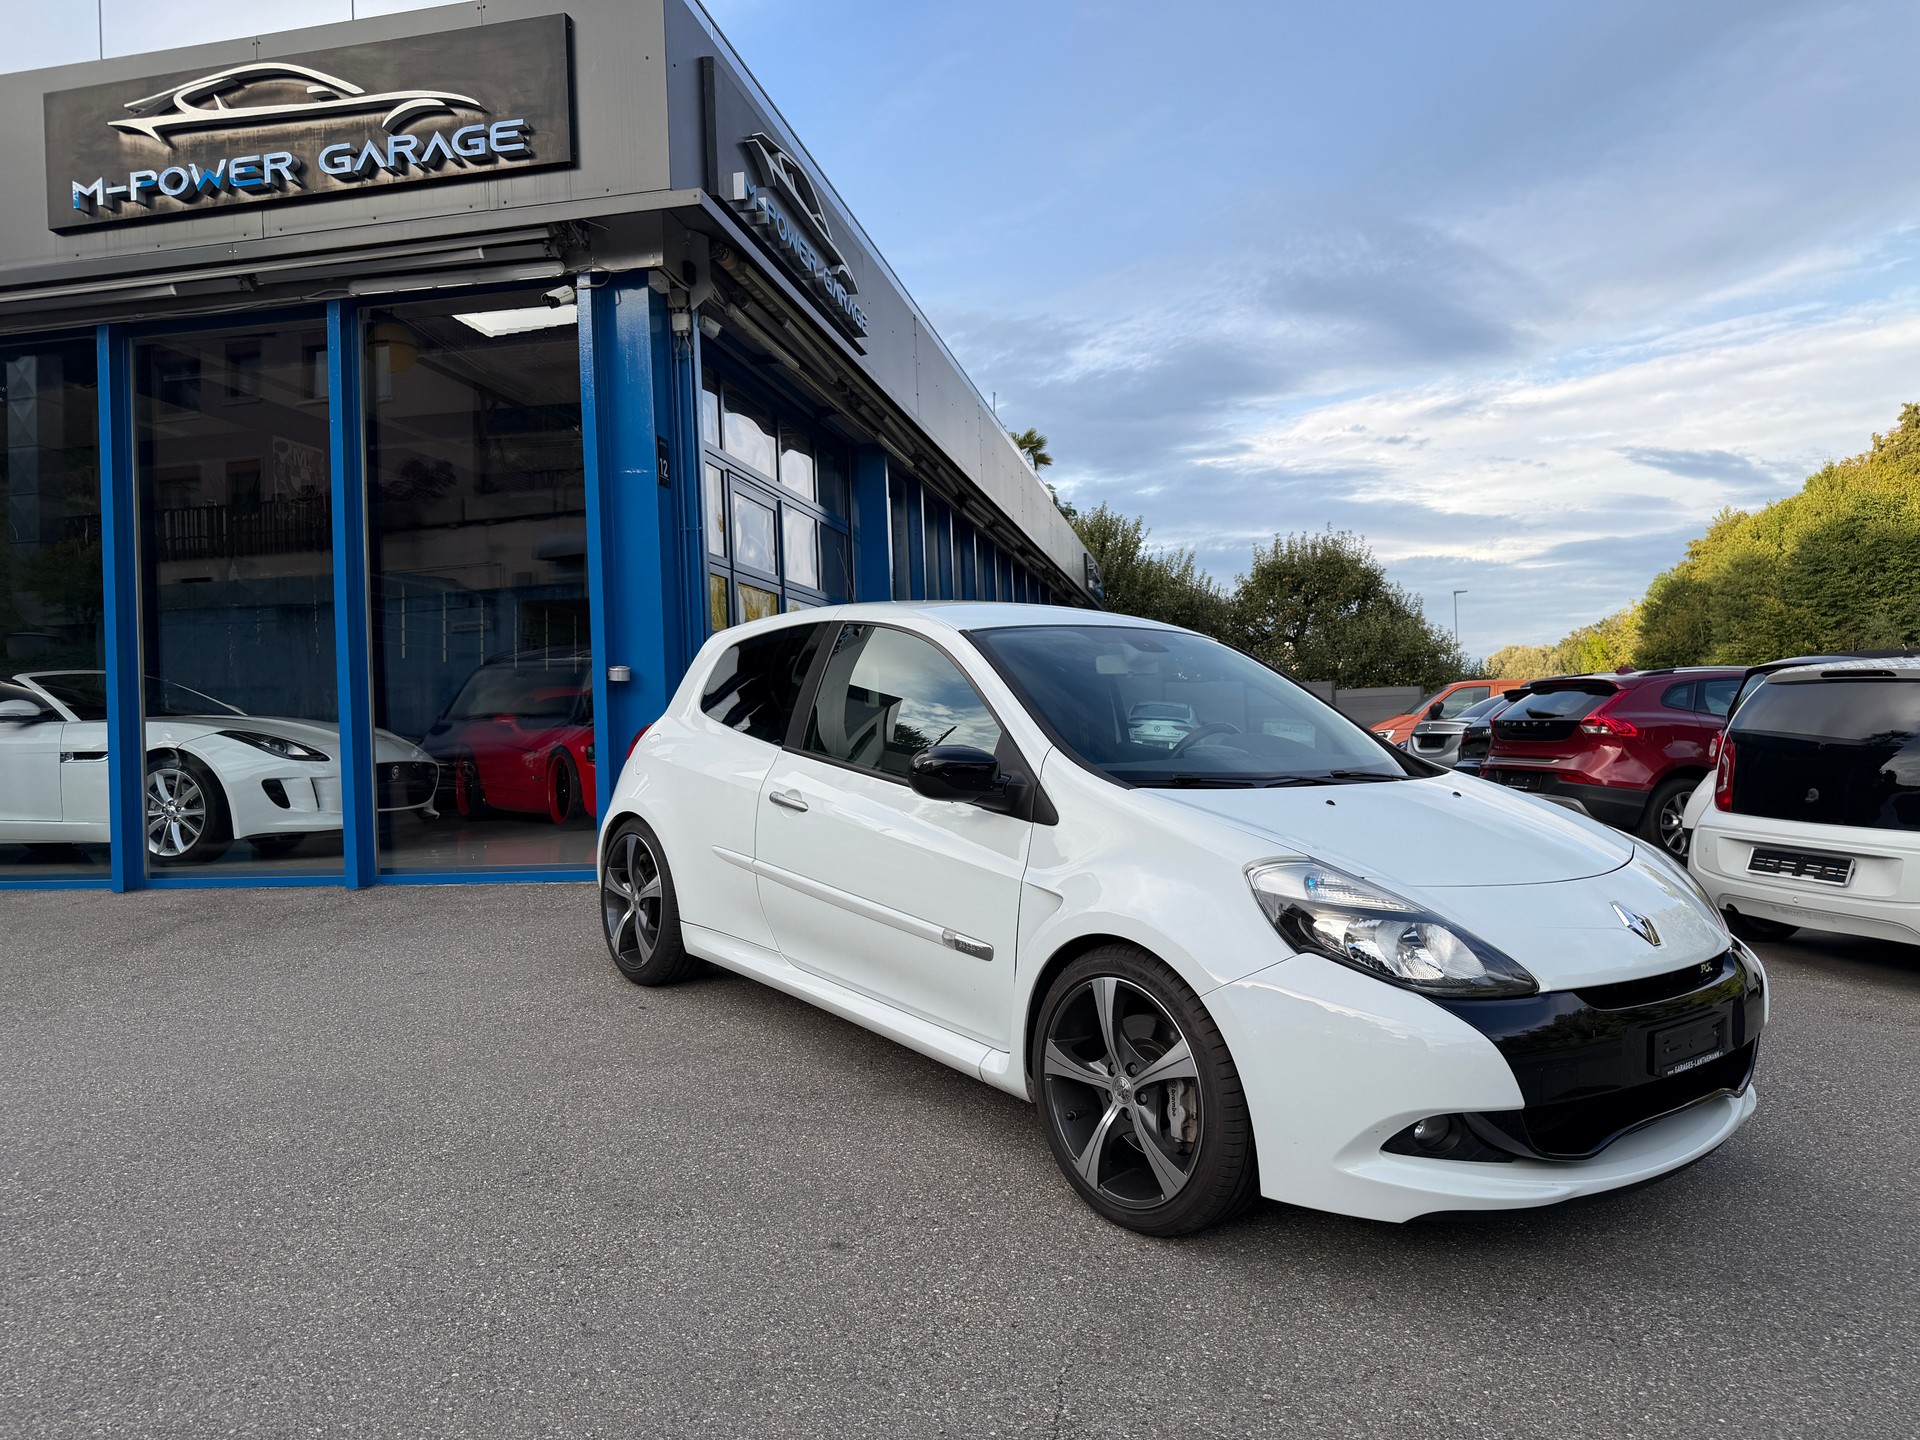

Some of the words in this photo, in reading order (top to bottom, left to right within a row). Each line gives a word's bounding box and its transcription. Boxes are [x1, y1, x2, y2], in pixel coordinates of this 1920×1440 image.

[72, 151, 295, 209] M-POWER
[319, 118, 526, 175] GARAGE
[743, 172, 818, 279] M-POWER
[823, 267, 869, 337] GARAGE
[659, 457, 668, 478] 12
